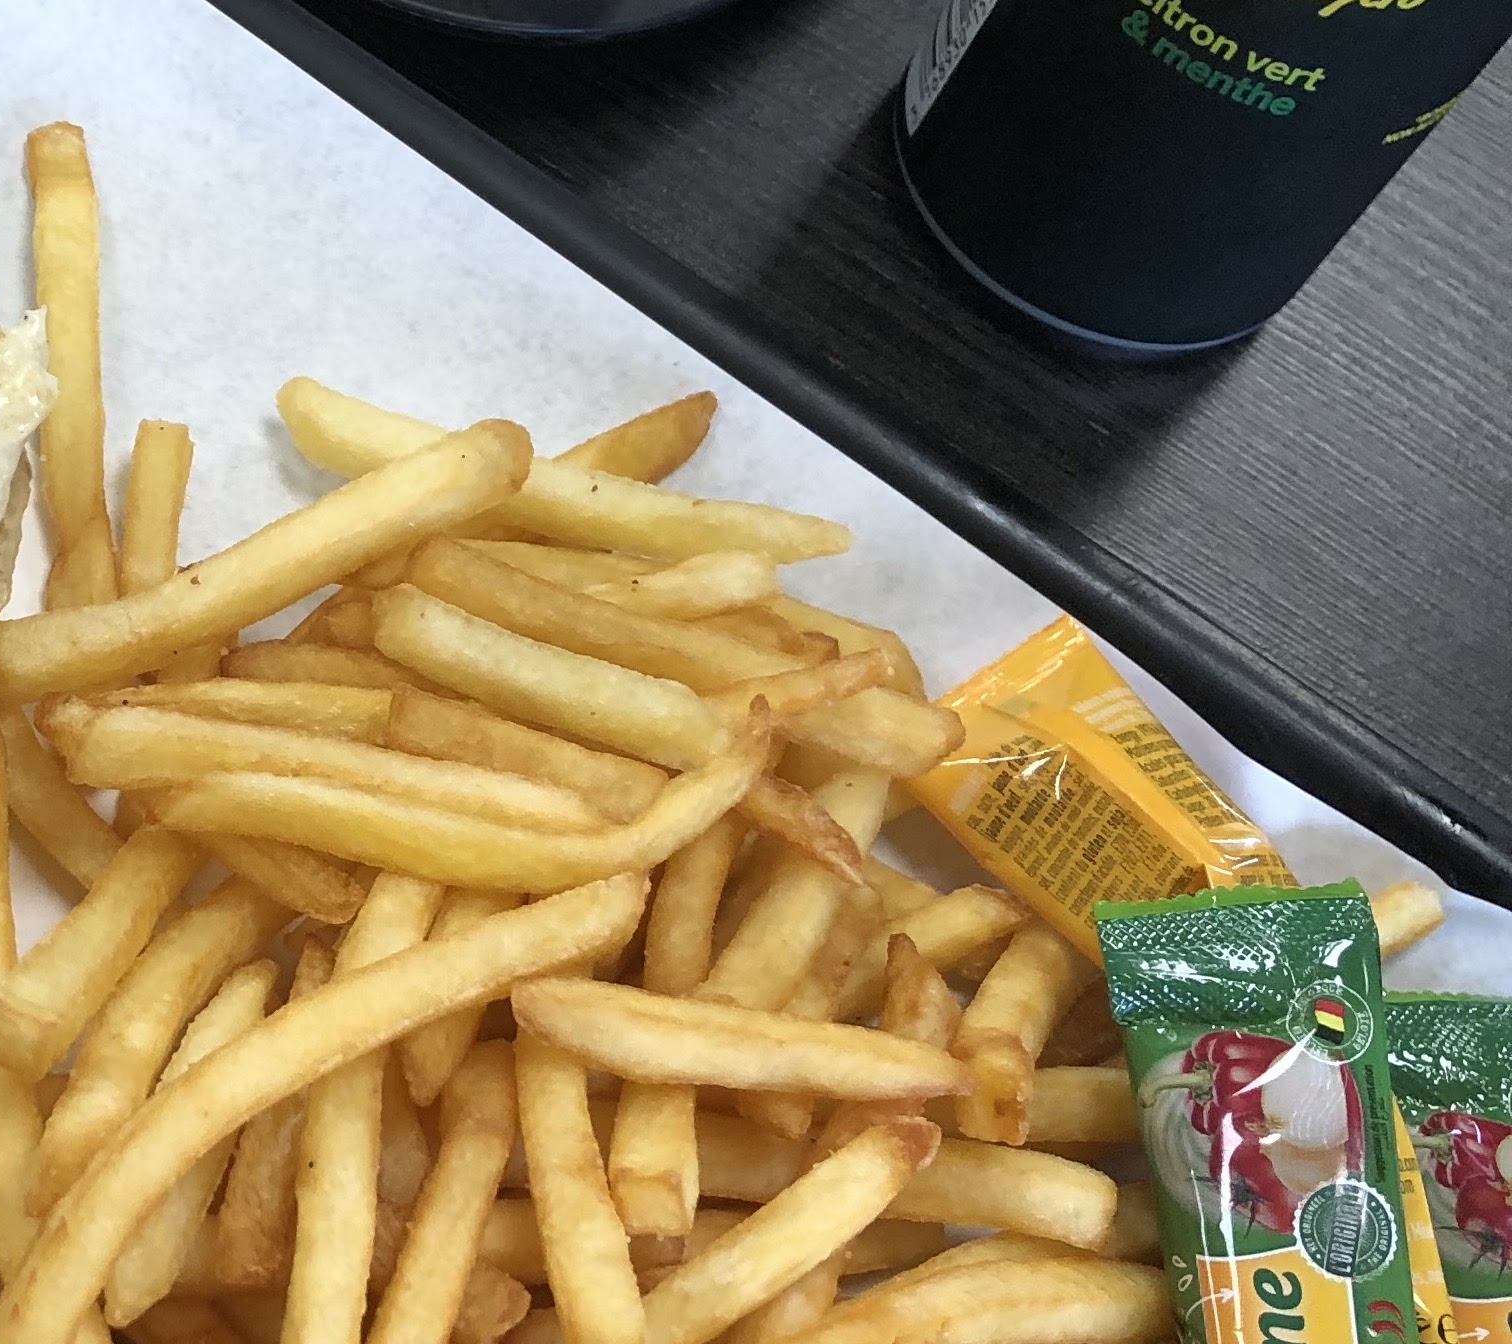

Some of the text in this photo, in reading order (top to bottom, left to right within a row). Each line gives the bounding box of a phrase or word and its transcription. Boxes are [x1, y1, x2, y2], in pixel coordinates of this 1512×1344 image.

[1120, 9, 1297, 116] & menthe
[1246, 50, 1326, 92] vert
